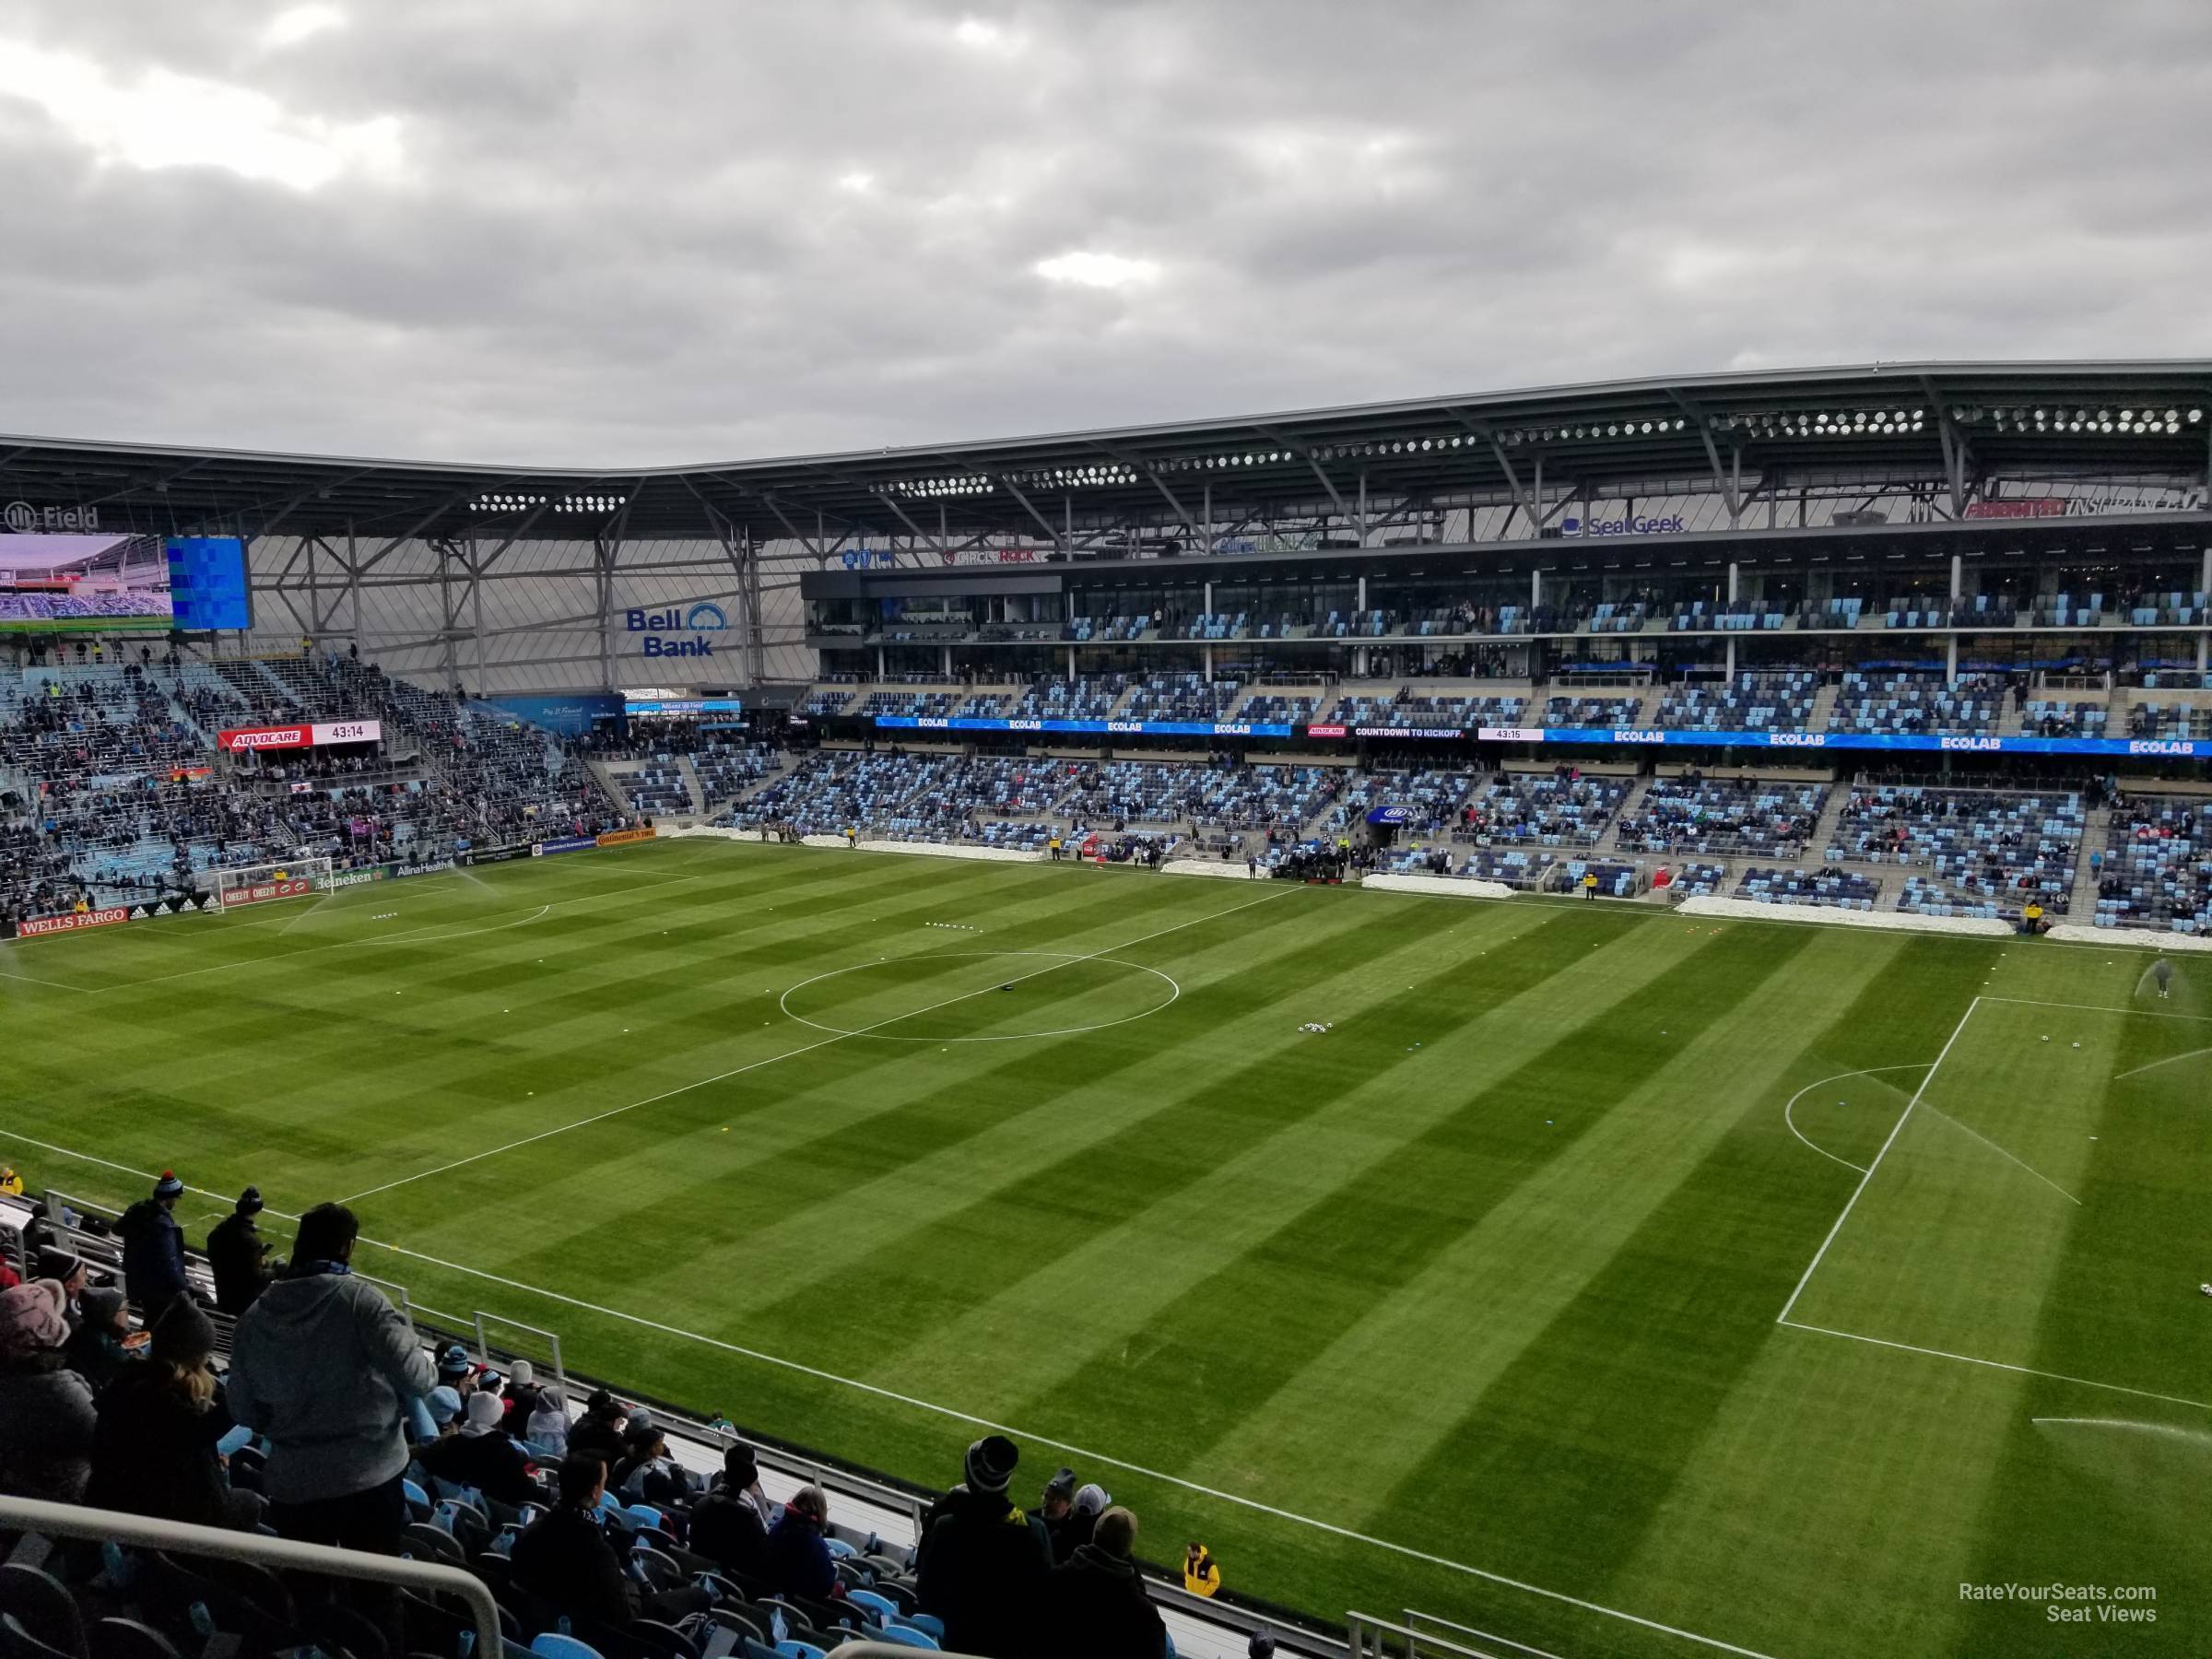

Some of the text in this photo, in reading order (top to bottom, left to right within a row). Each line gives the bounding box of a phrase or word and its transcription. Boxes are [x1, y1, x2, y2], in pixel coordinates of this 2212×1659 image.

[44, 506, 99, 529] Field
[627, 609, 681, 631] Bell
[643, 635, 713, 657] Bank
[918, 718, 948, 727] ECOLAB
[1008, 720, 1041, 730] ECOLAB
[1107, 722, 1142, 732] ECOLAB
[332, 725, 363, 738] 43:14
[1214, 724, 1251, 734] ECOLAB
[1356, 727, 1410, 736] COUNTDOWN
[1411, 728, 1422, 736] TO
[1496, 730, 1521, 738] 43:15
[232, 730, 301, 747] ADVOCARE
[1614, 731, 1665, 742] ECOLAB
[1770, 734, 1825, 746] ECOLAB
[1941, 737, 2001, 749] ECOLAB
[2129, 741, 2194, 754] ECOLAB
[597, 833, 635, 845] Continental
[314, 872, 371, 890] Heineken
[23, 918, 74, 935] WELLS
[76, 909, 124, 925] FARGO
